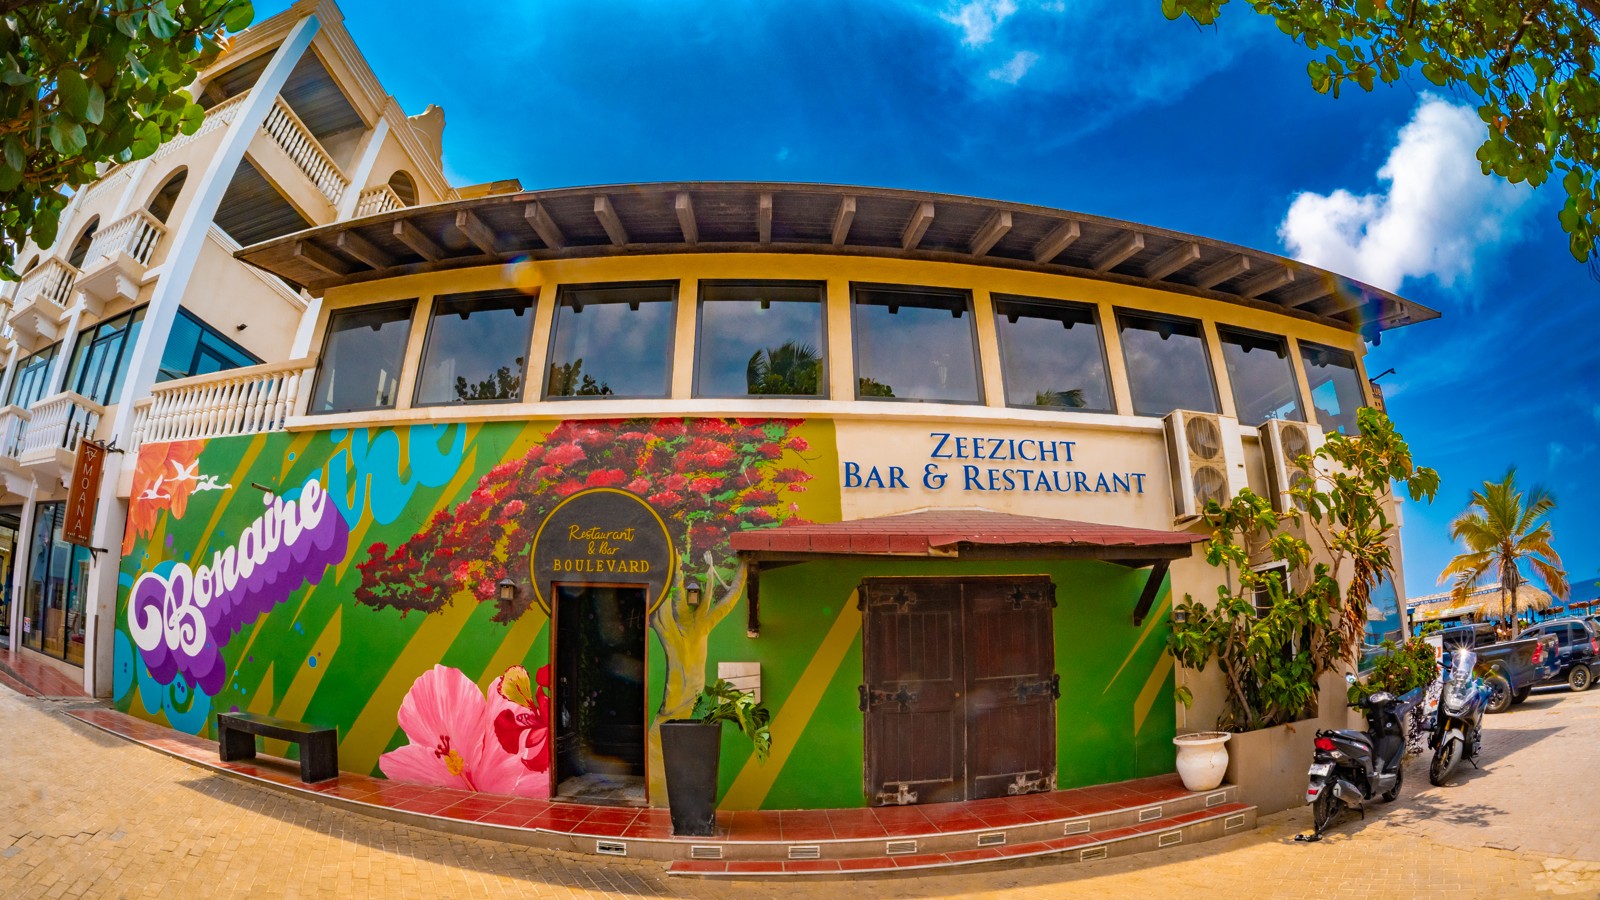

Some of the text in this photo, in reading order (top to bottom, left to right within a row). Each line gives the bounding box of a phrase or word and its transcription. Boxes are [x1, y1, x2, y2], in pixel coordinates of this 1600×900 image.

[929, 432, 1076, 462] ZEEZICHT
[843, 461, 1147, 493] BAR & RESTAURANT
[74, 463, 93, 531] MOANA
[568, 524, 636, 542] Restaurant
[587, 541, 620, 556] & Bar
[127, 478, 327, 657] Bonaire
[553, 559, 650, 573] BOULEVARD
